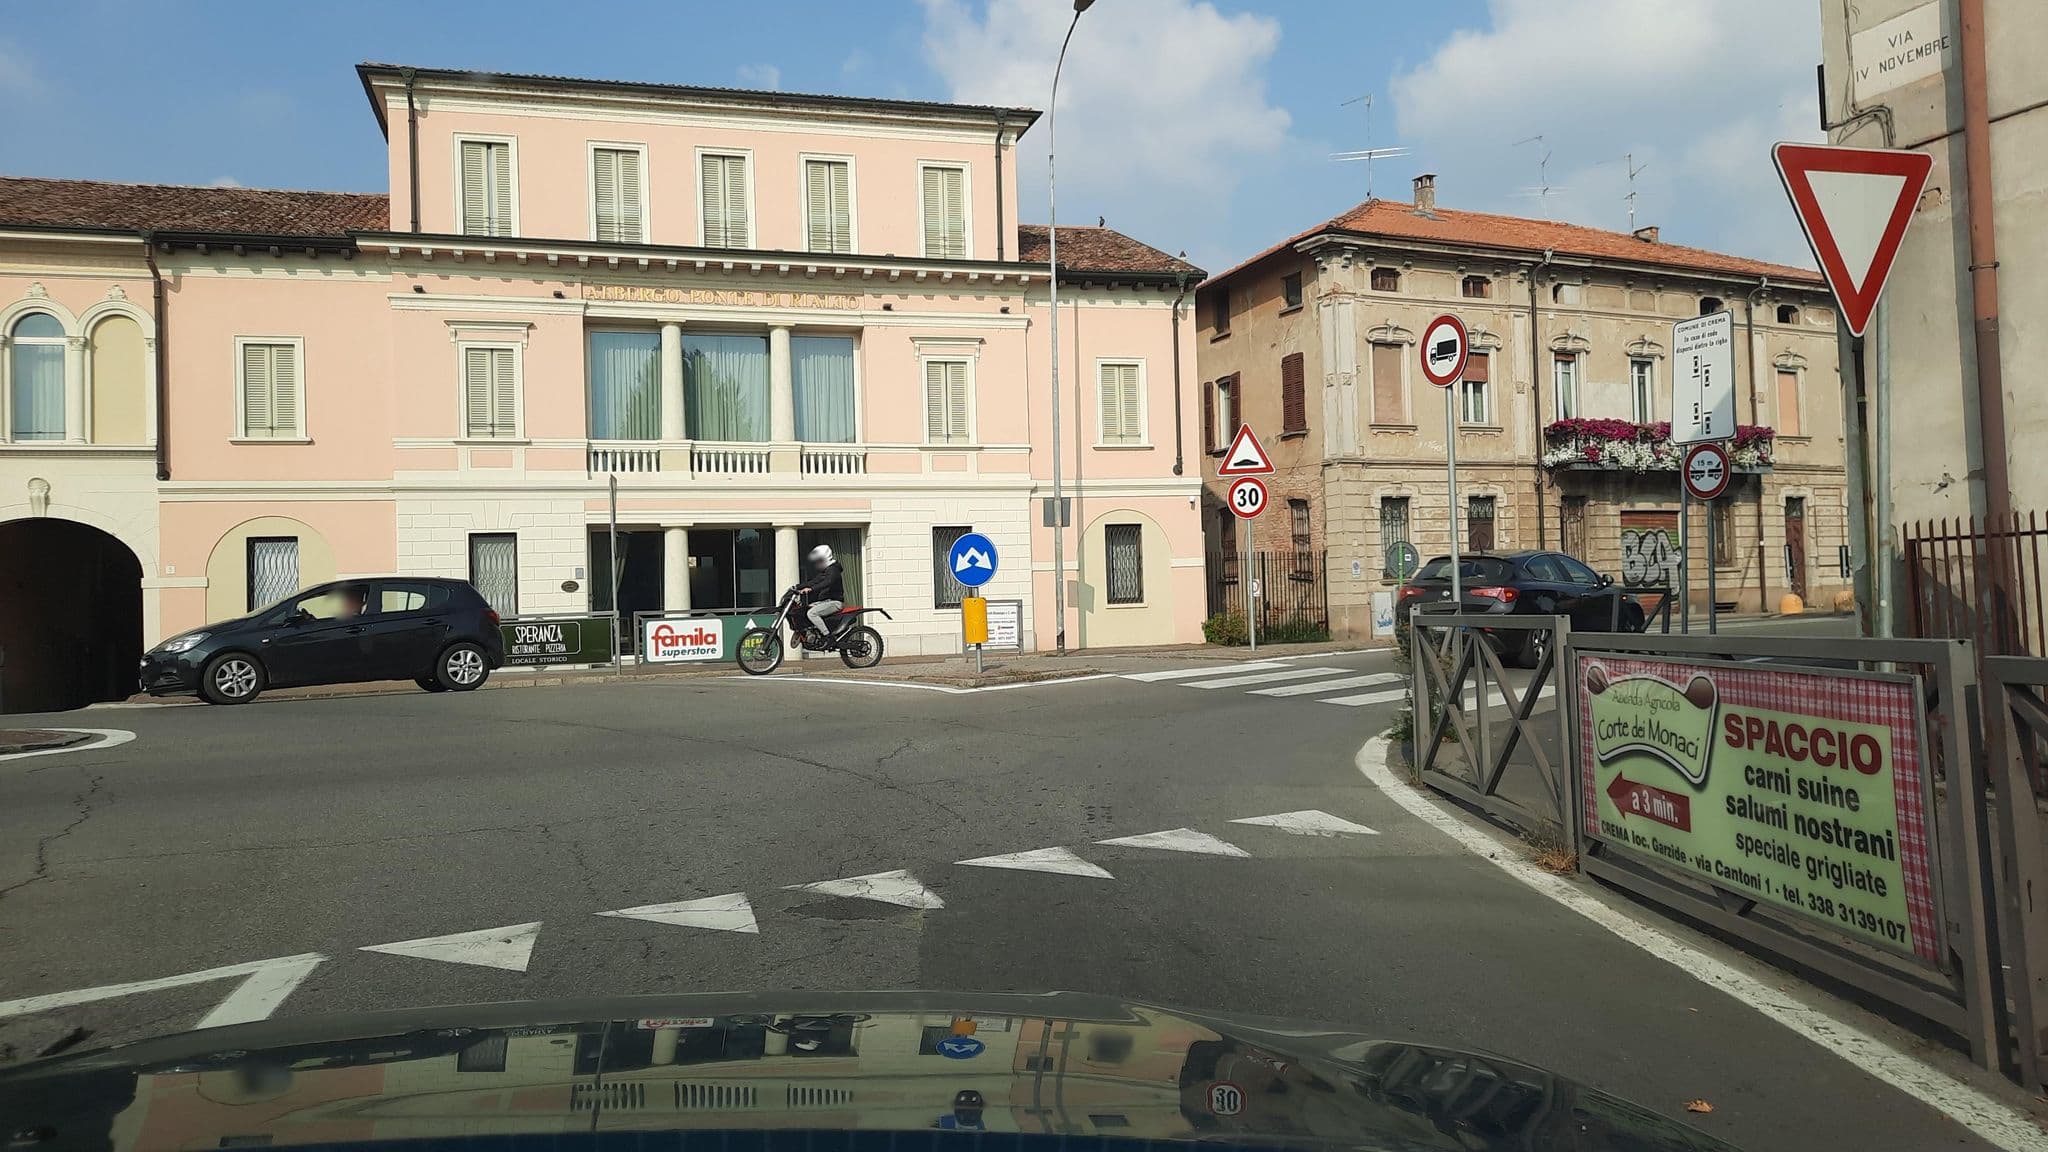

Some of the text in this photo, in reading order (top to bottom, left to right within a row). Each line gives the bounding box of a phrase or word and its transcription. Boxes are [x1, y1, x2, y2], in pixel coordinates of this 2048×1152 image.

[1888, 30, 1914, 48] VIA
[1855, 36, 1950, 82] IV NOVEMBRE
[587, 285, 861, 310] ALBERGO PONTE DI RIALTO
[1677, 323, 1699, 333] COMUNE
[1707, 317, 1726, 326] CREMA
[1237, 488, 1259, 507] 30
[512, 643, 567, 654] RISTORANTE PIZZERIA
[515, 625, 563, 644] SPERANZA
[651, 624, 717, 656] famila
[661, 647, 717, 658] superstore
[1644, 691, 1681, 715] Agricola
[1598, 715, 1700, 760] Corte dei Monaci
[1724, 713, 1883, 776] SPACCIO
[1744, 765, 1861, 812] carni suine
[1631, 790, 1679, 823] a 3 min.
[1726, 795, 1896, 862] salumi nostrani
[1736, 832, 1887, 897] speciale grigliate
[1601, 820, 1906, 943] CREMA loc. Garzide via Cantoni 1 tel. 338 3139107
